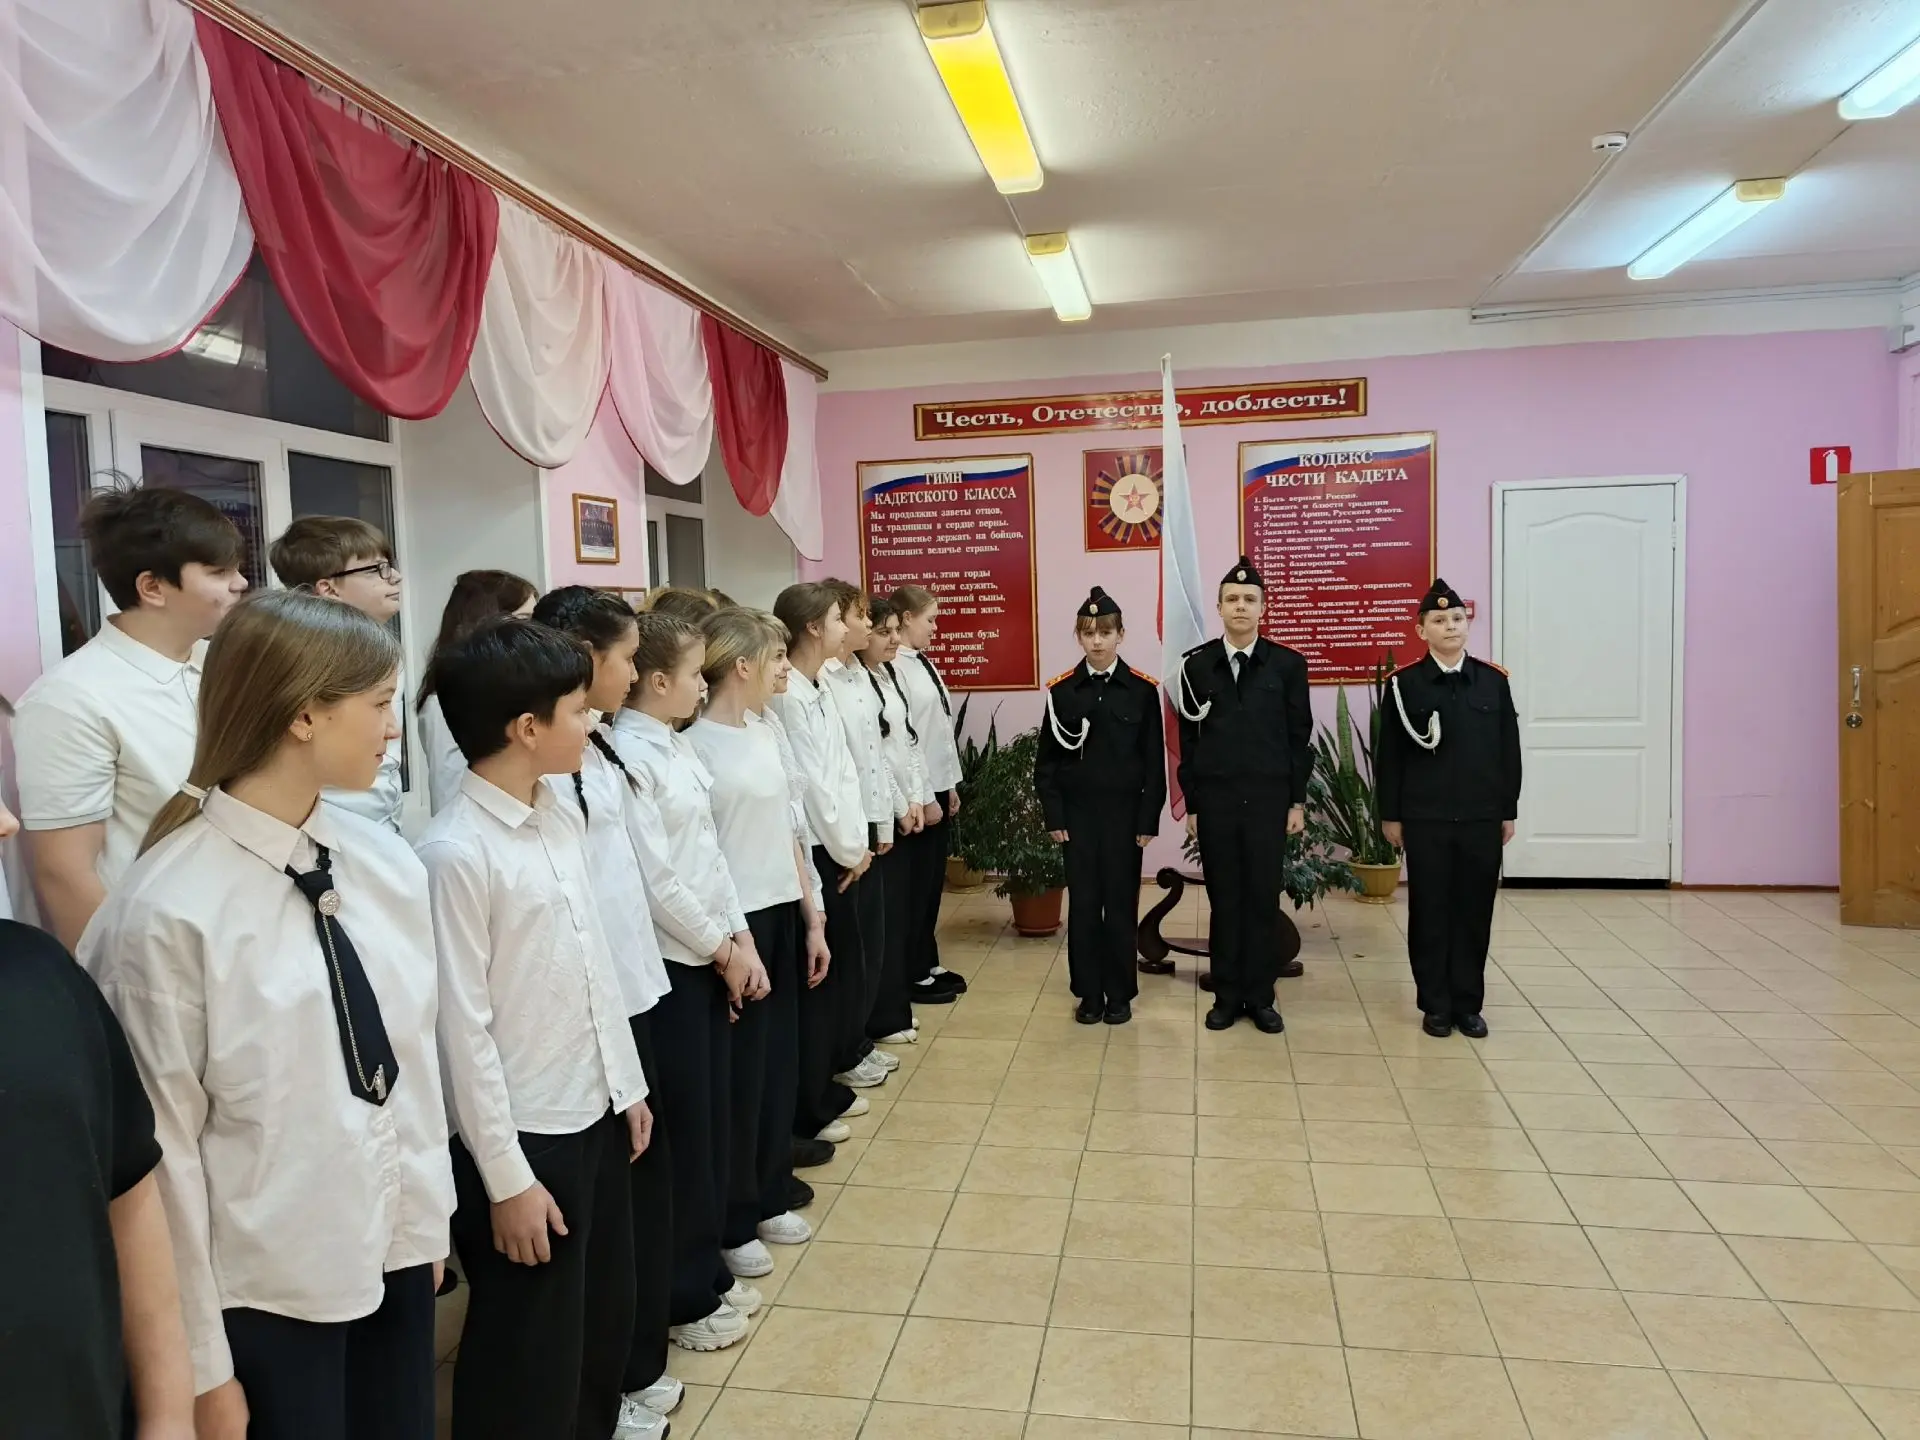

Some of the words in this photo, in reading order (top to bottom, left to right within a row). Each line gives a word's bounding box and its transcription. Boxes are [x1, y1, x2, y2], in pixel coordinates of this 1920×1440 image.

[934, 409, 1024, 428] Честь,
[1199, 388, 1347, 414] доблесть!
[1299, 451, 1373, 469] КОДЕКС
[925, 472, 963, 485] ГИМН
[1265, 473, 1325, 487] ЧЕСТИ
[1335, 469, 1408, 485] КАДЕТА
[875, 490, 958, 506] КАДЕТСКОГО
[965, 487, 1016, 500] КЛАССА
[871, 511, 885, 520] Мы
[890, 510, 937, 521] продолжим
[941, 508, 971, 517] заветы
[1263, 512, 1296, 520] Русской
[1333, 509, 1371, 517] Русского
[871, 524, 882, 532] Их
[946, 521, 975, 530] сердце
[871, 535, 889, 544] Нам
[936, 533, 971, 544] держать
[871, 546, 923, 557] Отстоявших
[888, 572, 918, 581] кадеты
[964, 570, 990, 578] горды
[873, 585, 880, 593] И
[931, 583, 956, 591] будем
[960, 582, 998, 592] служить,
[1268, 585, 1314, 593] Соблюдать
[1268, 601, 1314, 609] Соблюдать
[941, 631, 973, 642] верным
[978, 628, 999, 639] будь!
[950, 643, 984, 653] дорожи!
[951, 666, 980, 677] служи!
